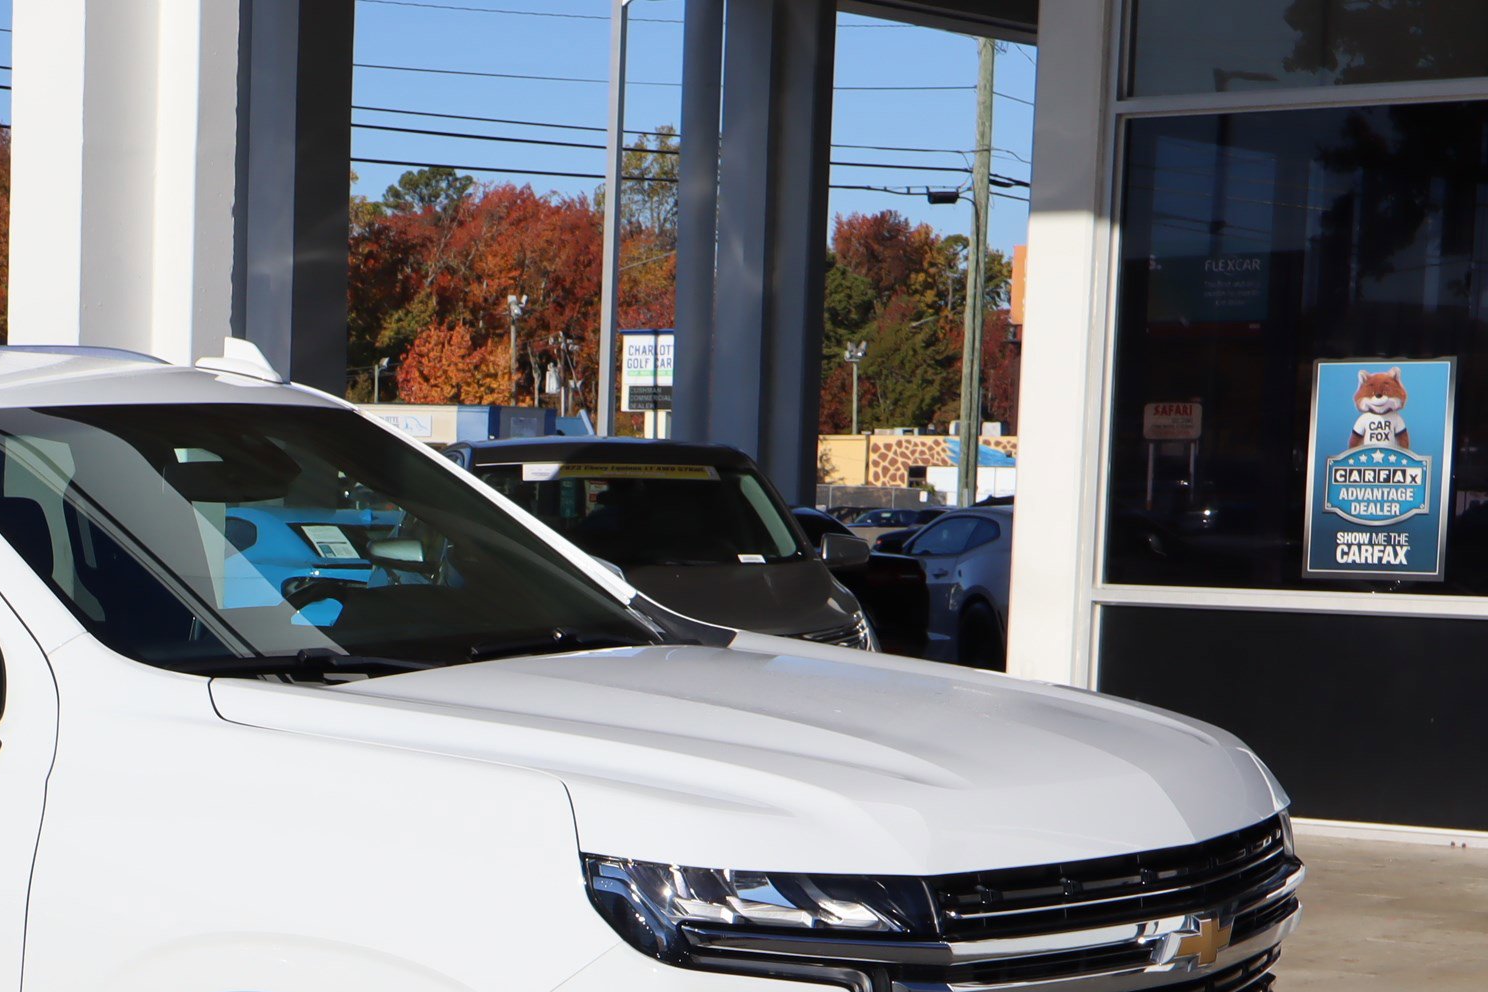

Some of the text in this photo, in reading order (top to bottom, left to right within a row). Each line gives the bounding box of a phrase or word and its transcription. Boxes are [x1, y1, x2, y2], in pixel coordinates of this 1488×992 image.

[1204, 258, 1261, 274] FLEXCAR
[627, 358, 650, 369] GOLF
[1153, 404, 1193, 416] SAFARI
[1368, 421, 1391, 431] CAR
[1369, 432, 1390, 442] FOX
[1334, 468, 1421, 484] CARFAX
[1339, 488, 1414, 501] ADVANTAGE
[1350, 502, 1400, 515] DEALER
[1336, 532, 1409, 545] SHOW ME THE
[1336, 545, 1409, 565] CARFAX
